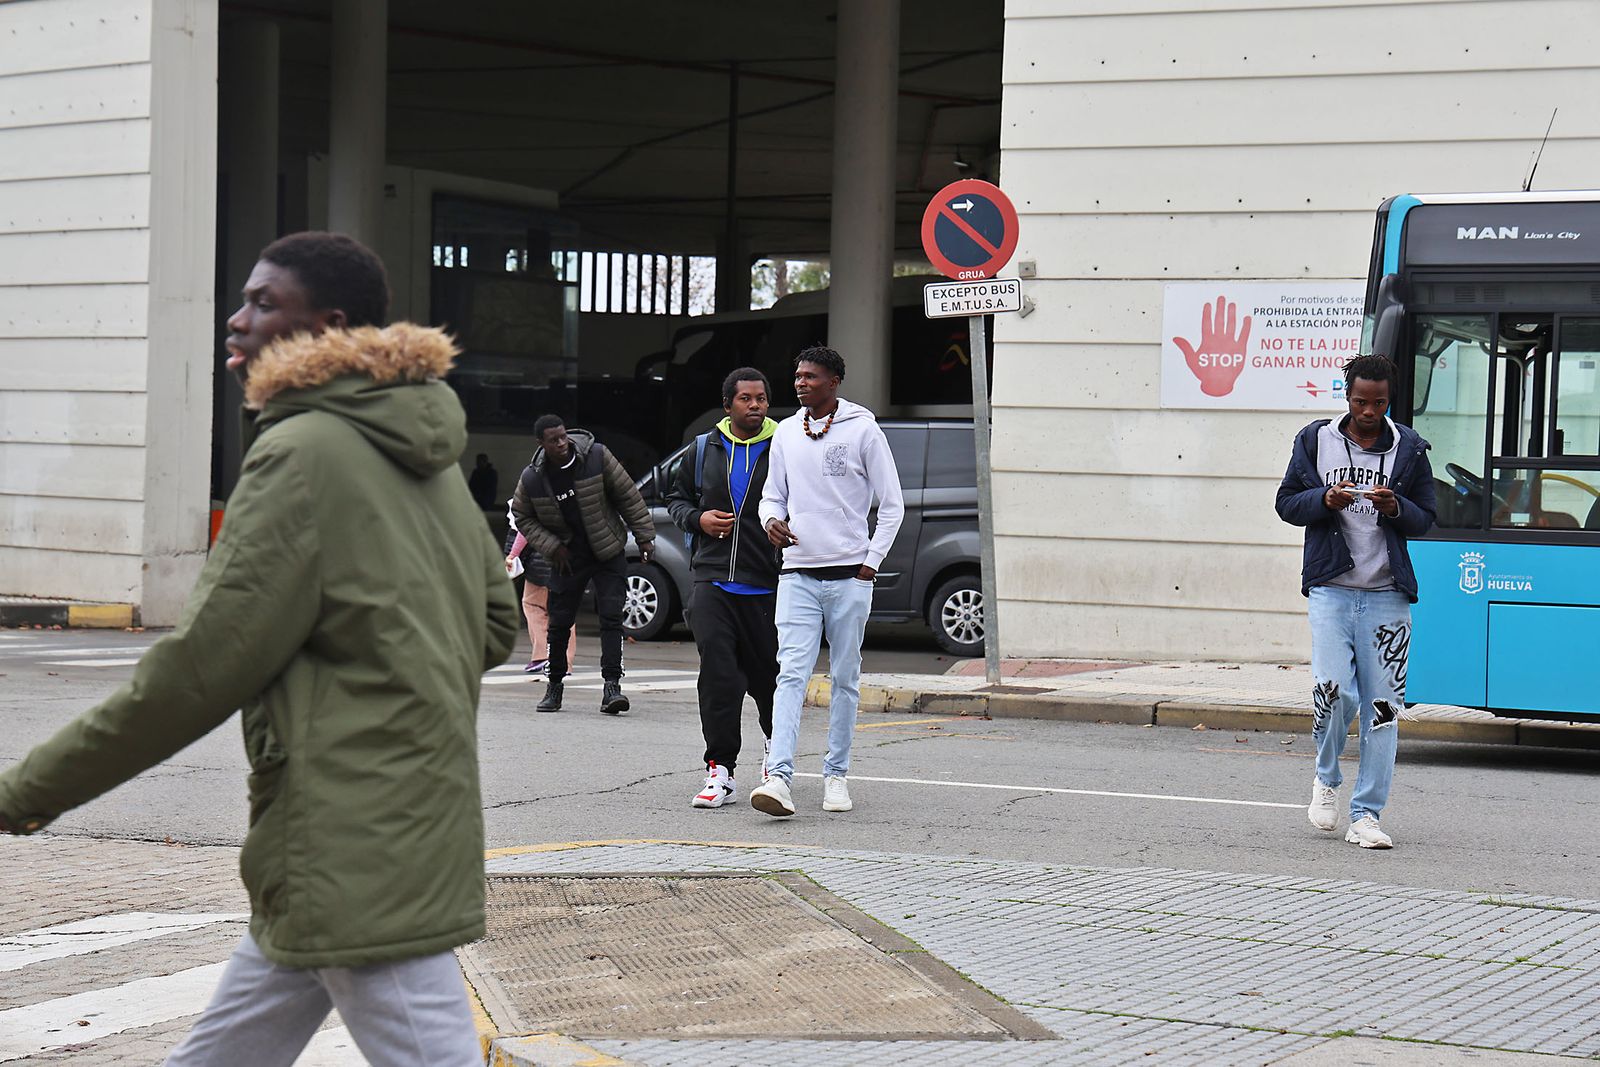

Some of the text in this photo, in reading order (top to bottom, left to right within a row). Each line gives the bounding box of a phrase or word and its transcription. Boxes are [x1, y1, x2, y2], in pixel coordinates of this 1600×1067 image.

[1456, 226, 1519, 240] MAN
[1557, 231, 1581, 240] City
[958, 270, 986, 279] GRUA
[932, 283, 1015, 300] EXCEPTO BUS
[941, 298, 1008, 312] E.M.T.U.S.A.
[1281, 295, 1295, 304] Por
[1298, 295, 1335, 304] motivos
[1336, 295, 1349, 304] de
[1253, 307, 1309, 316] PROHIBIDA
[1311, 307, 1323, 316] LA
[1266, 317, 1362, 328] A LA ESTACIÓN POR
[1260, 338, 1359, 350] NO TE LA JUE
[1198, 353, 1244, 367] STOP
[1251, 356, 1345, 368] GANAR UNO
[1487, 580, 1533, 591] HUELVA
